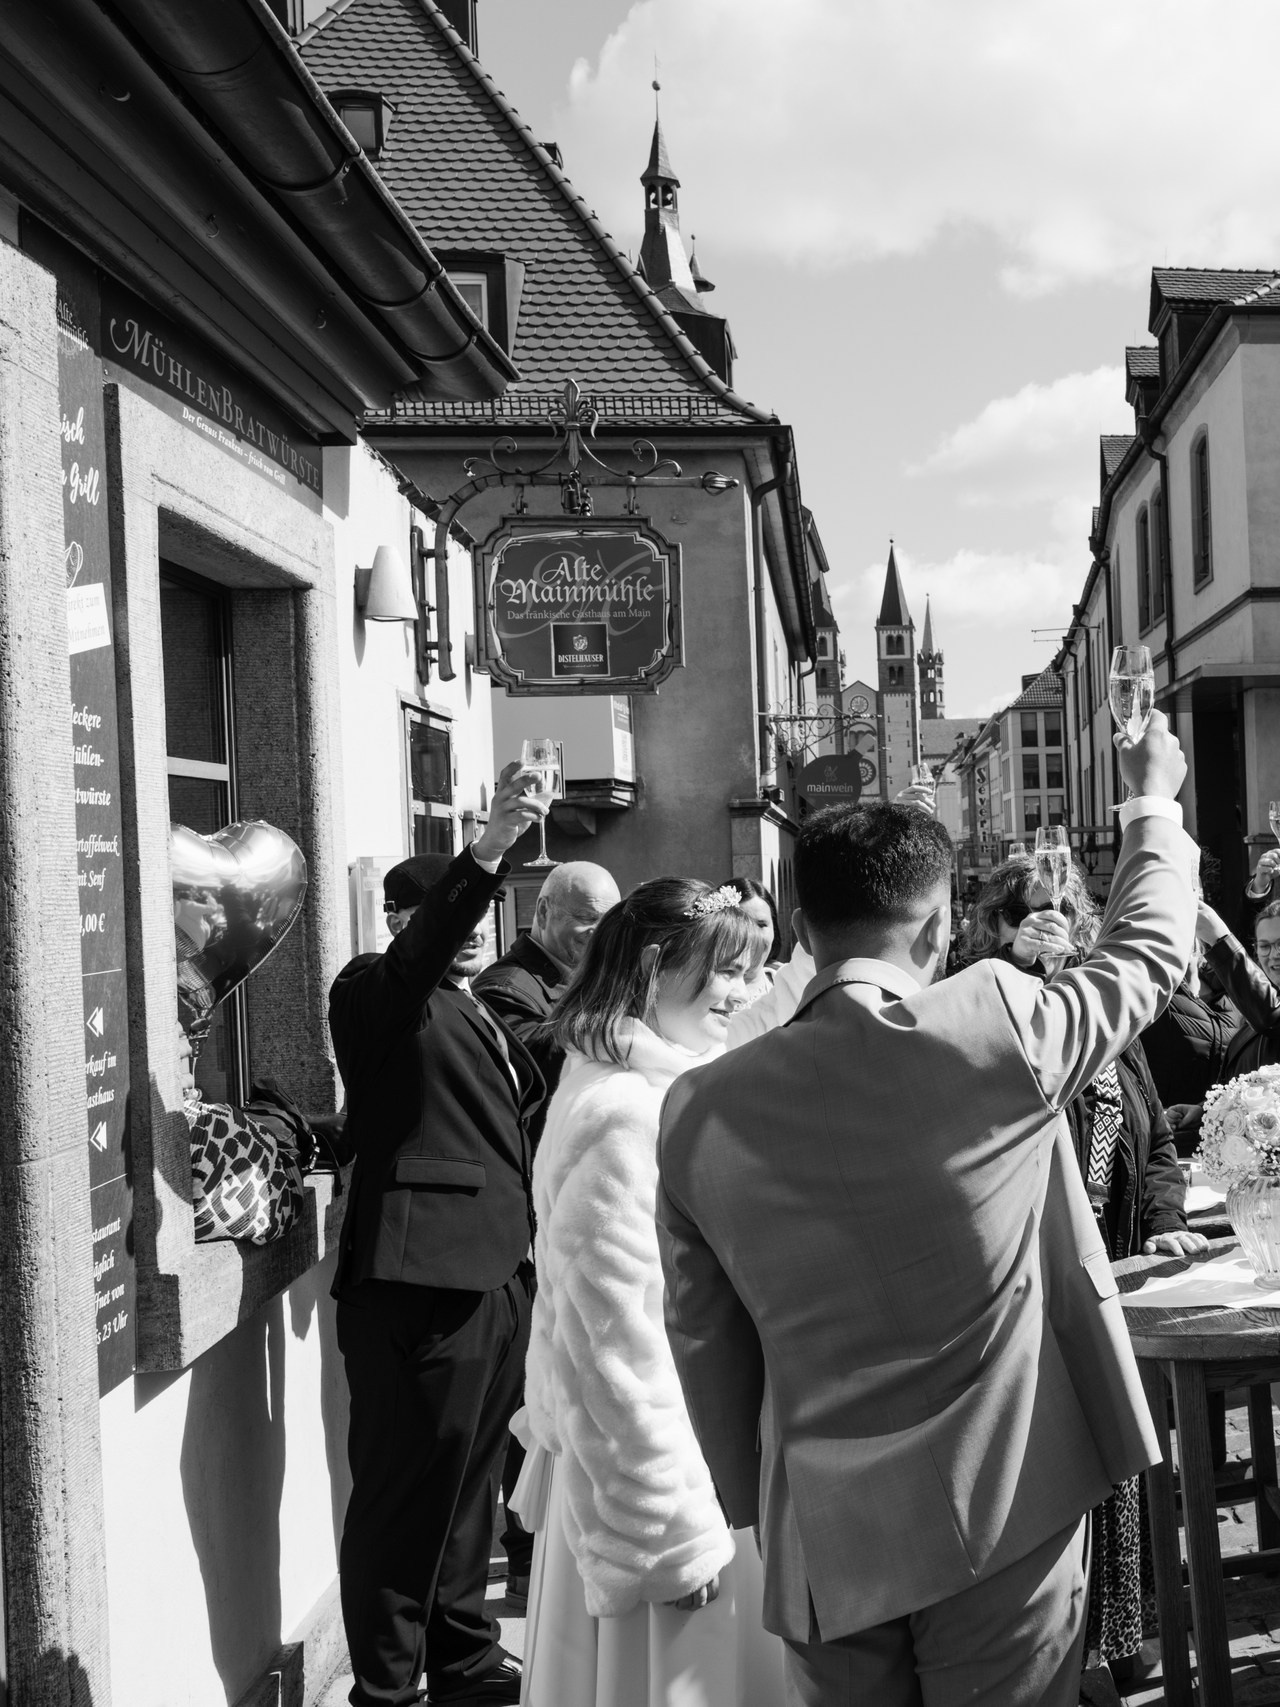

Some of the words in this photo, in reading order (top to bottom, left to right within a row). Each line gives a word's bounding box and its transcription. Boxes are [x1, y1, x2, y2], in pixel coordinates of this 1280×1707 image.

[60, 406, 85, 445] isch
[182, 406, 196, 424] Der
[196, 416, 218, 439] Genuss
[218, 430, 244, 457] Frankens
[248, 451, 263, 469] frisch
[69, 461, 100, 506] Grill
[541, 555, 603, 583] Alte
[501, 575, 655, 609] Mainmühle
[507, 610, 524, 620] Das
[526, 609, 571, 619] fränkische
[572, 608, 611, 618] Gasthaus
[612, 610, 629, 618] am
[628, 609, 651, 617] Main
[75, 787, 111, 806] twürste
[806, 782, 854, 793] mainwein
[88, 867, 107, 891] Senf
[86, 1050, 107, 1077] rkauf
[86, 1086, 115, 1109] asthaus
[102, 1321, 112, 1342] 23
[112, 1309, 128, 1333] Uhr
